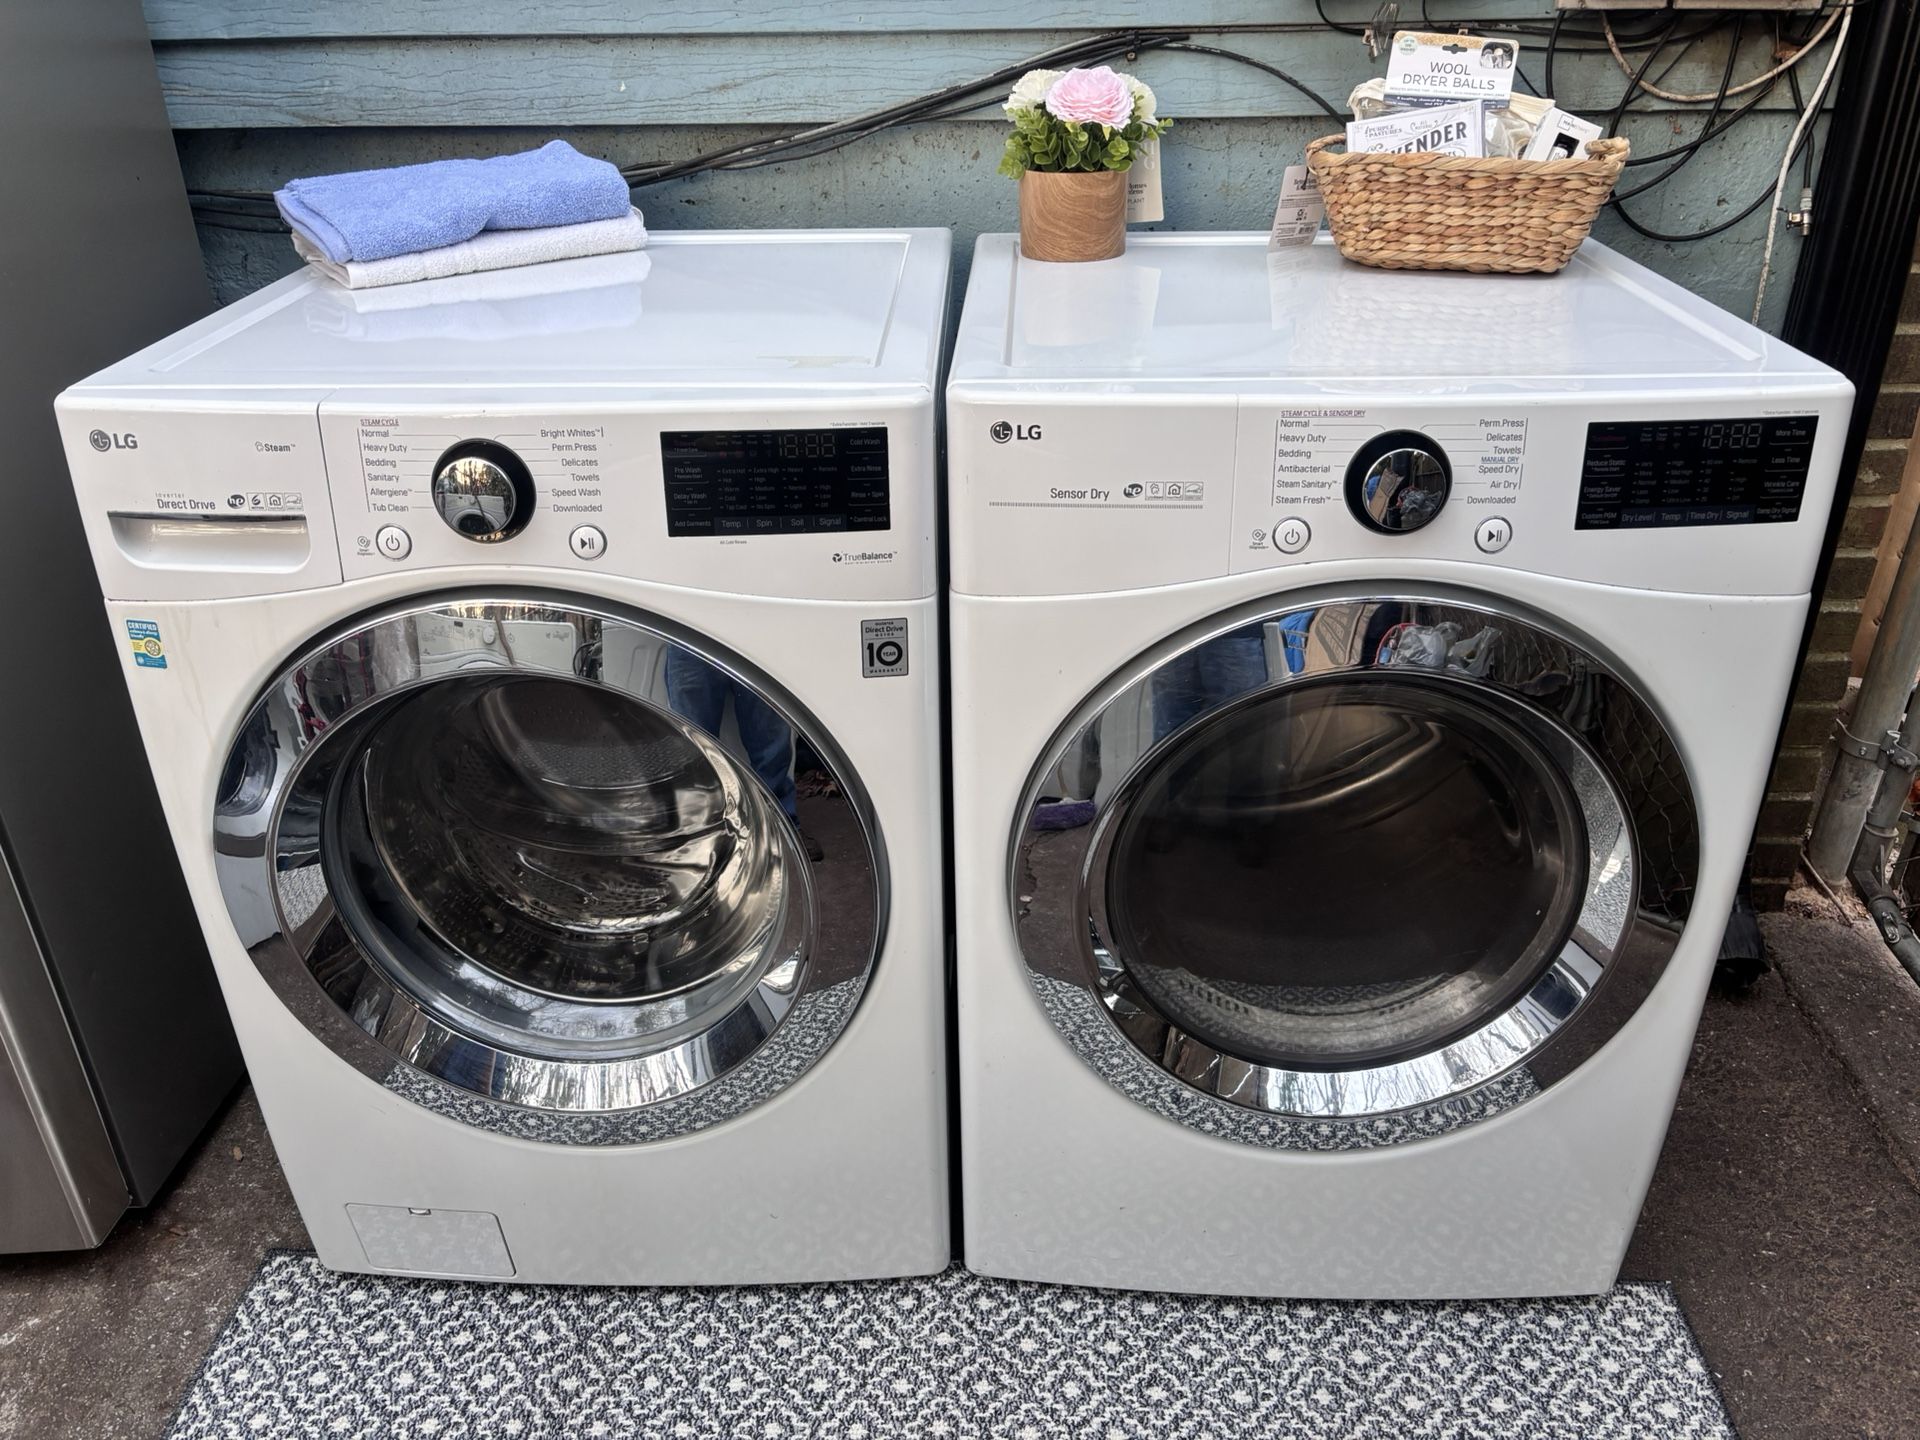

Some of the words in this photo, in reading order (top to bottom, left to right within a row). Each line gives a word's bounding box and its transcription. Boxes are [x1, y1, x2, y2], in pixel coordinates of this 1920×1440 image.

[1430, 61, 1472, 76] WOOL
[1402, 74, 1448, 87] DRYER
[1453, 78, 1495, 90] BALLS
[1280, 419, 1310, 428] Normal
[362, 429, 389, 438] Normal
[541, 429, 566, 438] Bright
[1016, 424, 1042, 440] LG
[113, 432, 138, 449] LG
[1280, 434, 1305, 443] Heavy
[1307, 434, 1326, 443] Duty
[1486, 433, 1523, 442] Delicates
[364, 444, 387, 452] Heavy
[389, 444, 407, 452] Duty
[1493, 446, 1522, 455] Towels
[1278, 449, 1311, 459] Bedding
[366, 458, 396, 468] Bedding
[562, 458, 598, 467] Delicates
[1278, 464, 1330, 473] Antibacterial
[1478, 465, 1502, 475] Speed
[1504, 465, 1519, 475] Dry
[368, 473, 399, 482] Sanitary
[571, 473, 600, 481] Towels
[1277, 480, 1300, 488] Steam
[1490, 480, 1500, 488] Air
[1502, 480, 1518, 490] Dry
[552, 489, 575, 497] Speed
[577, 488, 601, 496] Wash
[1050, 488, 1088, 499] Sensor
[1090, 489, 1110, 501] Dry
[157, 499, 188, 509] Direct
[189, 500, 216, 510] Drive
[1276, 496, 1300, 504] Steam
[1467, 496, 1516, 504] Downloaded
[373, 504, 386, 512] Tub
[388, 504, 409, 512] Clean
[553, 504, 602, 512] Downloaded
[1622, 514, 1632, 522] Dry
[1635, 513, 1652, 521] Level
[1661, 512, 1681, 521] Temp
[1690, 511, 1706, 519] Time
[1706, 512, 1719, 520] Dry
[1726, 510, 1750, 520] Signal
[721, 520, 742, 528] Temp
[756, 520, 772, 528] Spin
[791, 518, 804, 526] Soil
[819, 517, 841, 526] Signal
[867, 641, 903, 667] 10
